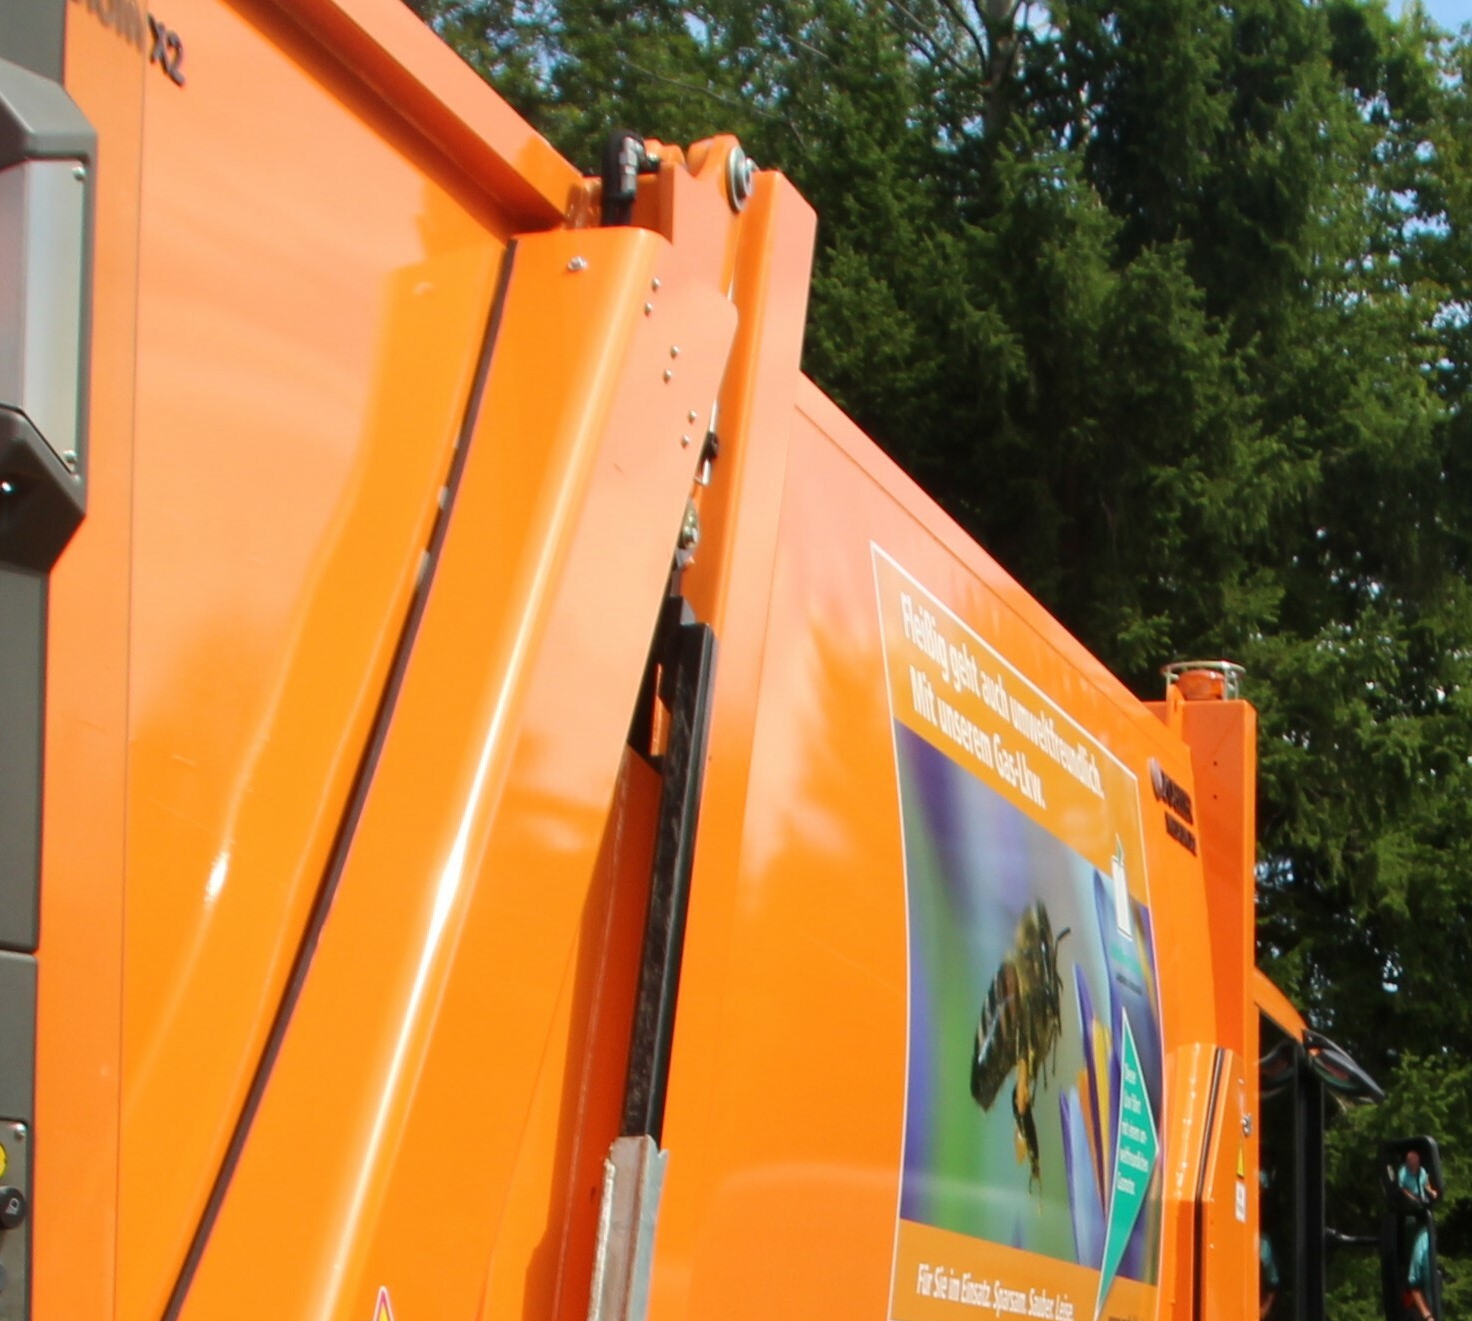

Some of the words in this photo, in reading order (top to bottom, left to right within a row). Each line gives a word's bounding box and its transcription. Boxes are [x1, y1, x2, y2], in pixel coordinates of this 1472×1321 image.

[147, 12, 186, 89] X2
[900, 591, 950, 684] Fleißig
[949, 642, 981, 699] geht
[980, 670, 1011, 723] auch
[1009, 695, 1105, 801] umweltfreundlich.
[909, 664, 938, 727] Mit
[937, 695, 994, 770] unserem
[993, 732, 1047, 811] Gas-Lkw.
[916, 1262, 934, 1298] Für
[933, 1266, 948, 1300] Sie
[947, 1268, 960, 1302] im
[960, 1271, 992, 1308] Einsatz.
[1028, 1286, 1055, 1321] Sauber.
